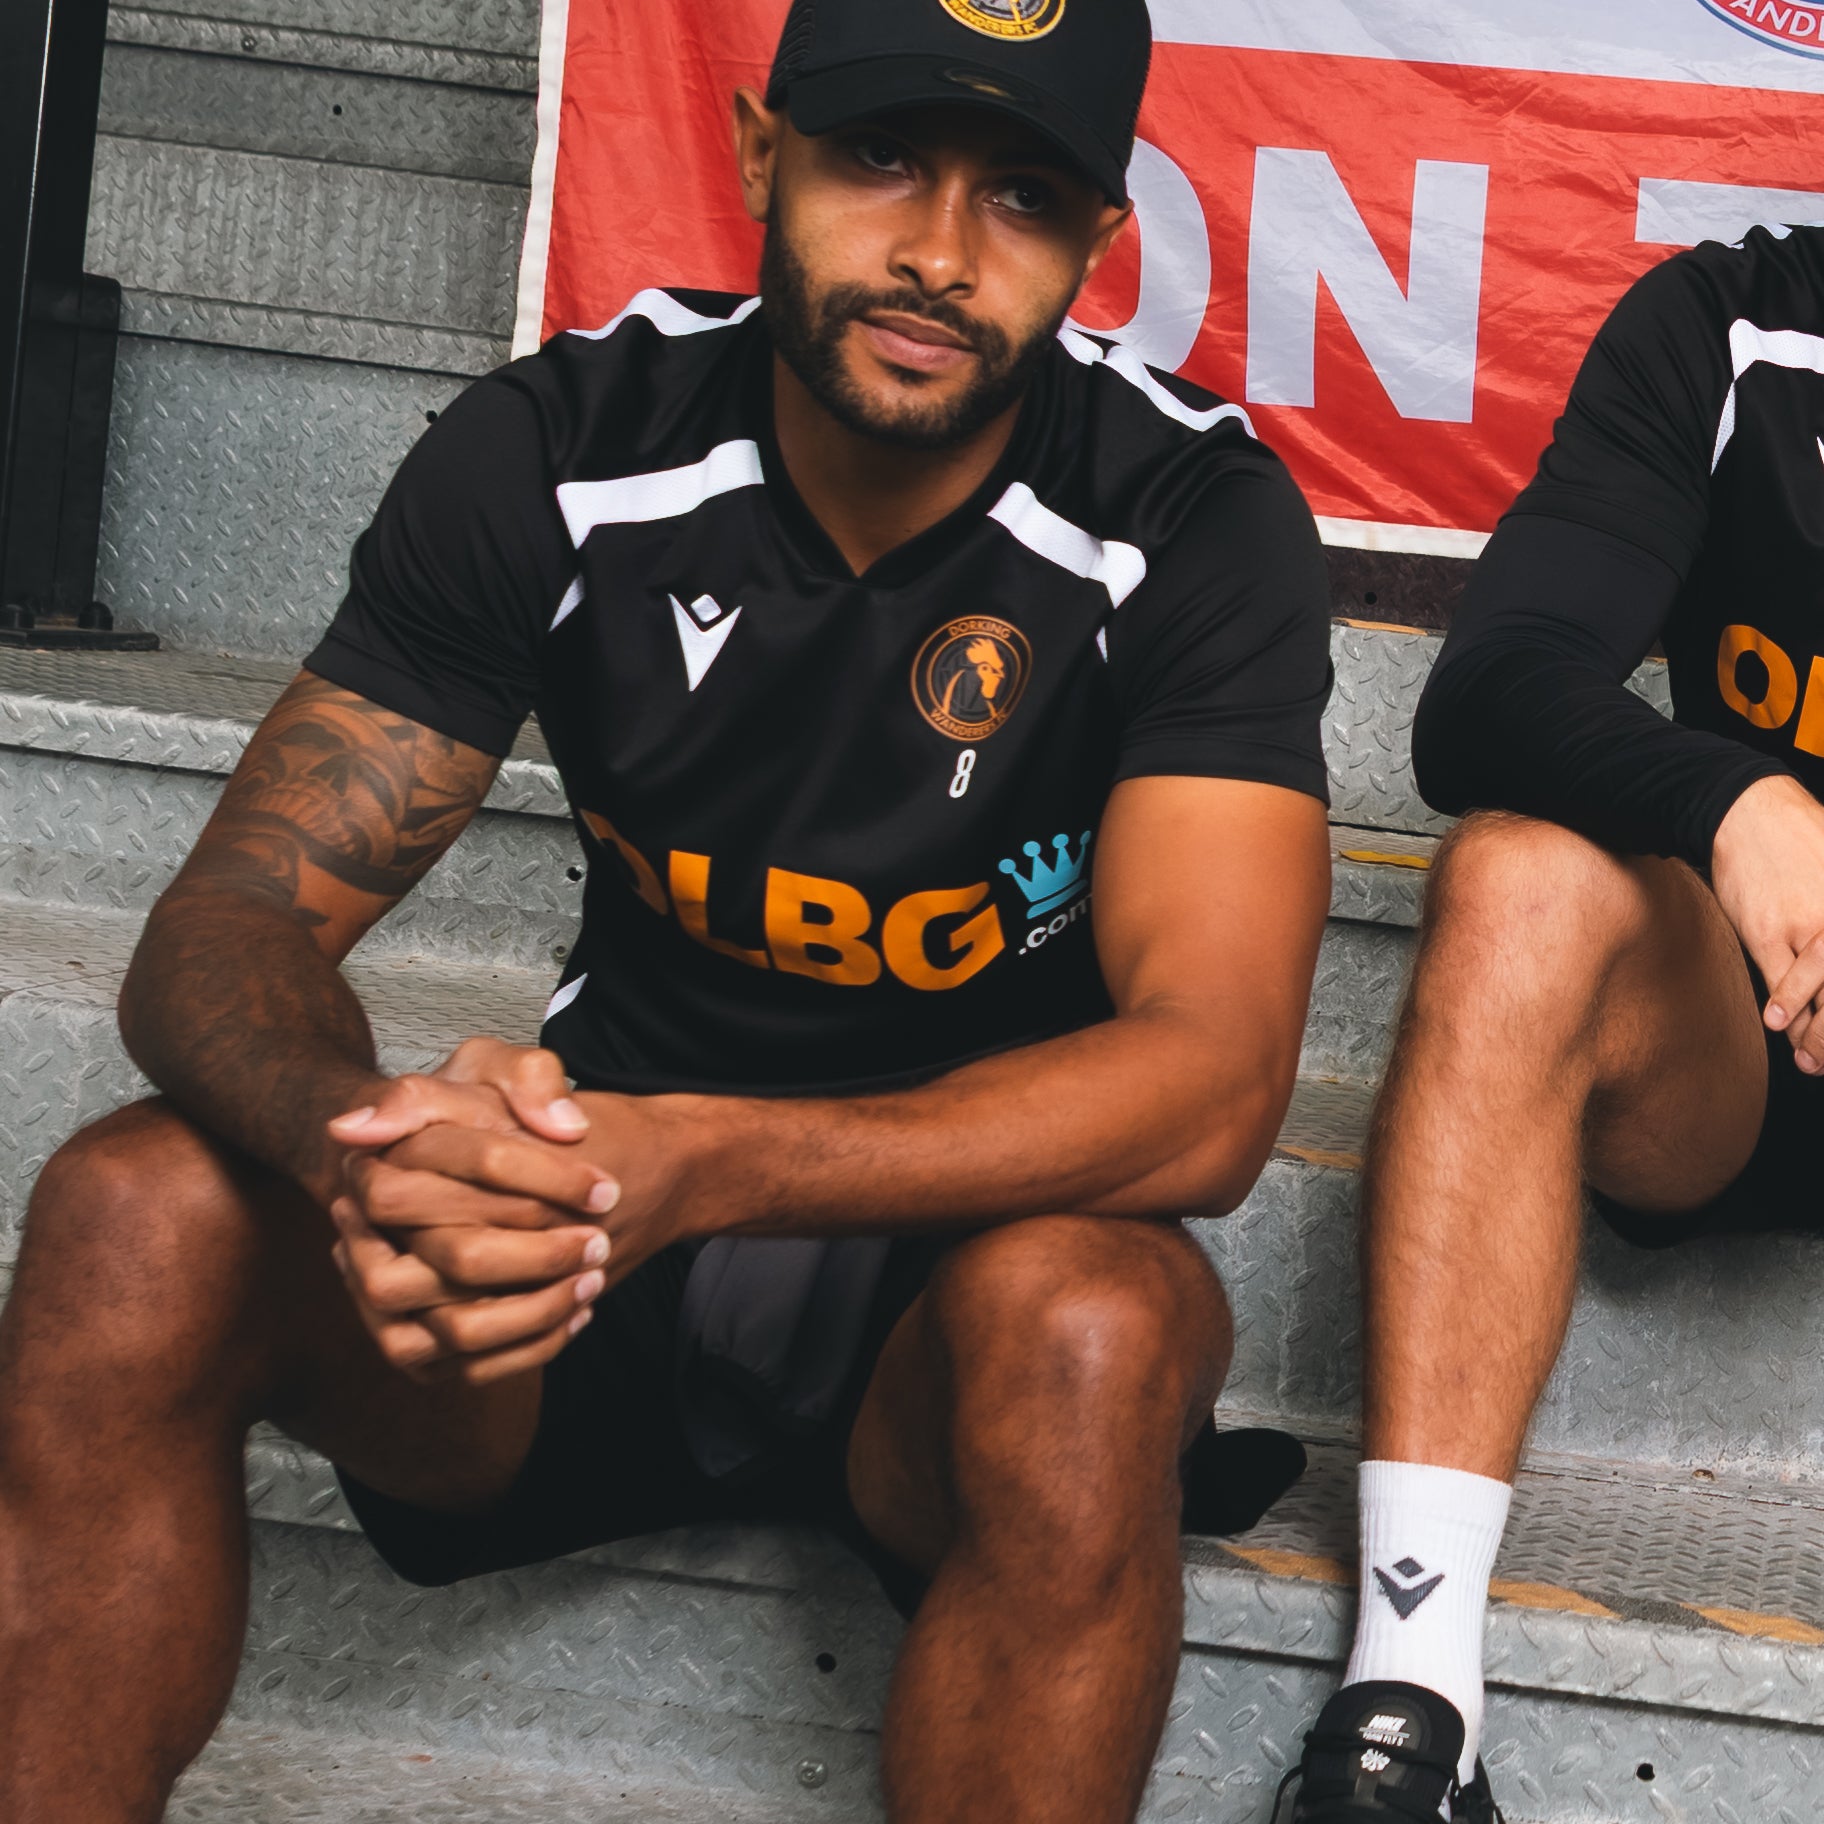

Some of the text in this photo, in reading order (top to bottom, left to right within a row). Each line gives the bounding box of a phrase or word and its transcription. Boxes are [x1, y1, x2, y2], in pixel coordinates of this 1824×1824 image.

[947, 620, 1012, 640] DORKING
[949, 748, 977, 799] 8
[1366, 1714, 1408, 1733] NIKE
